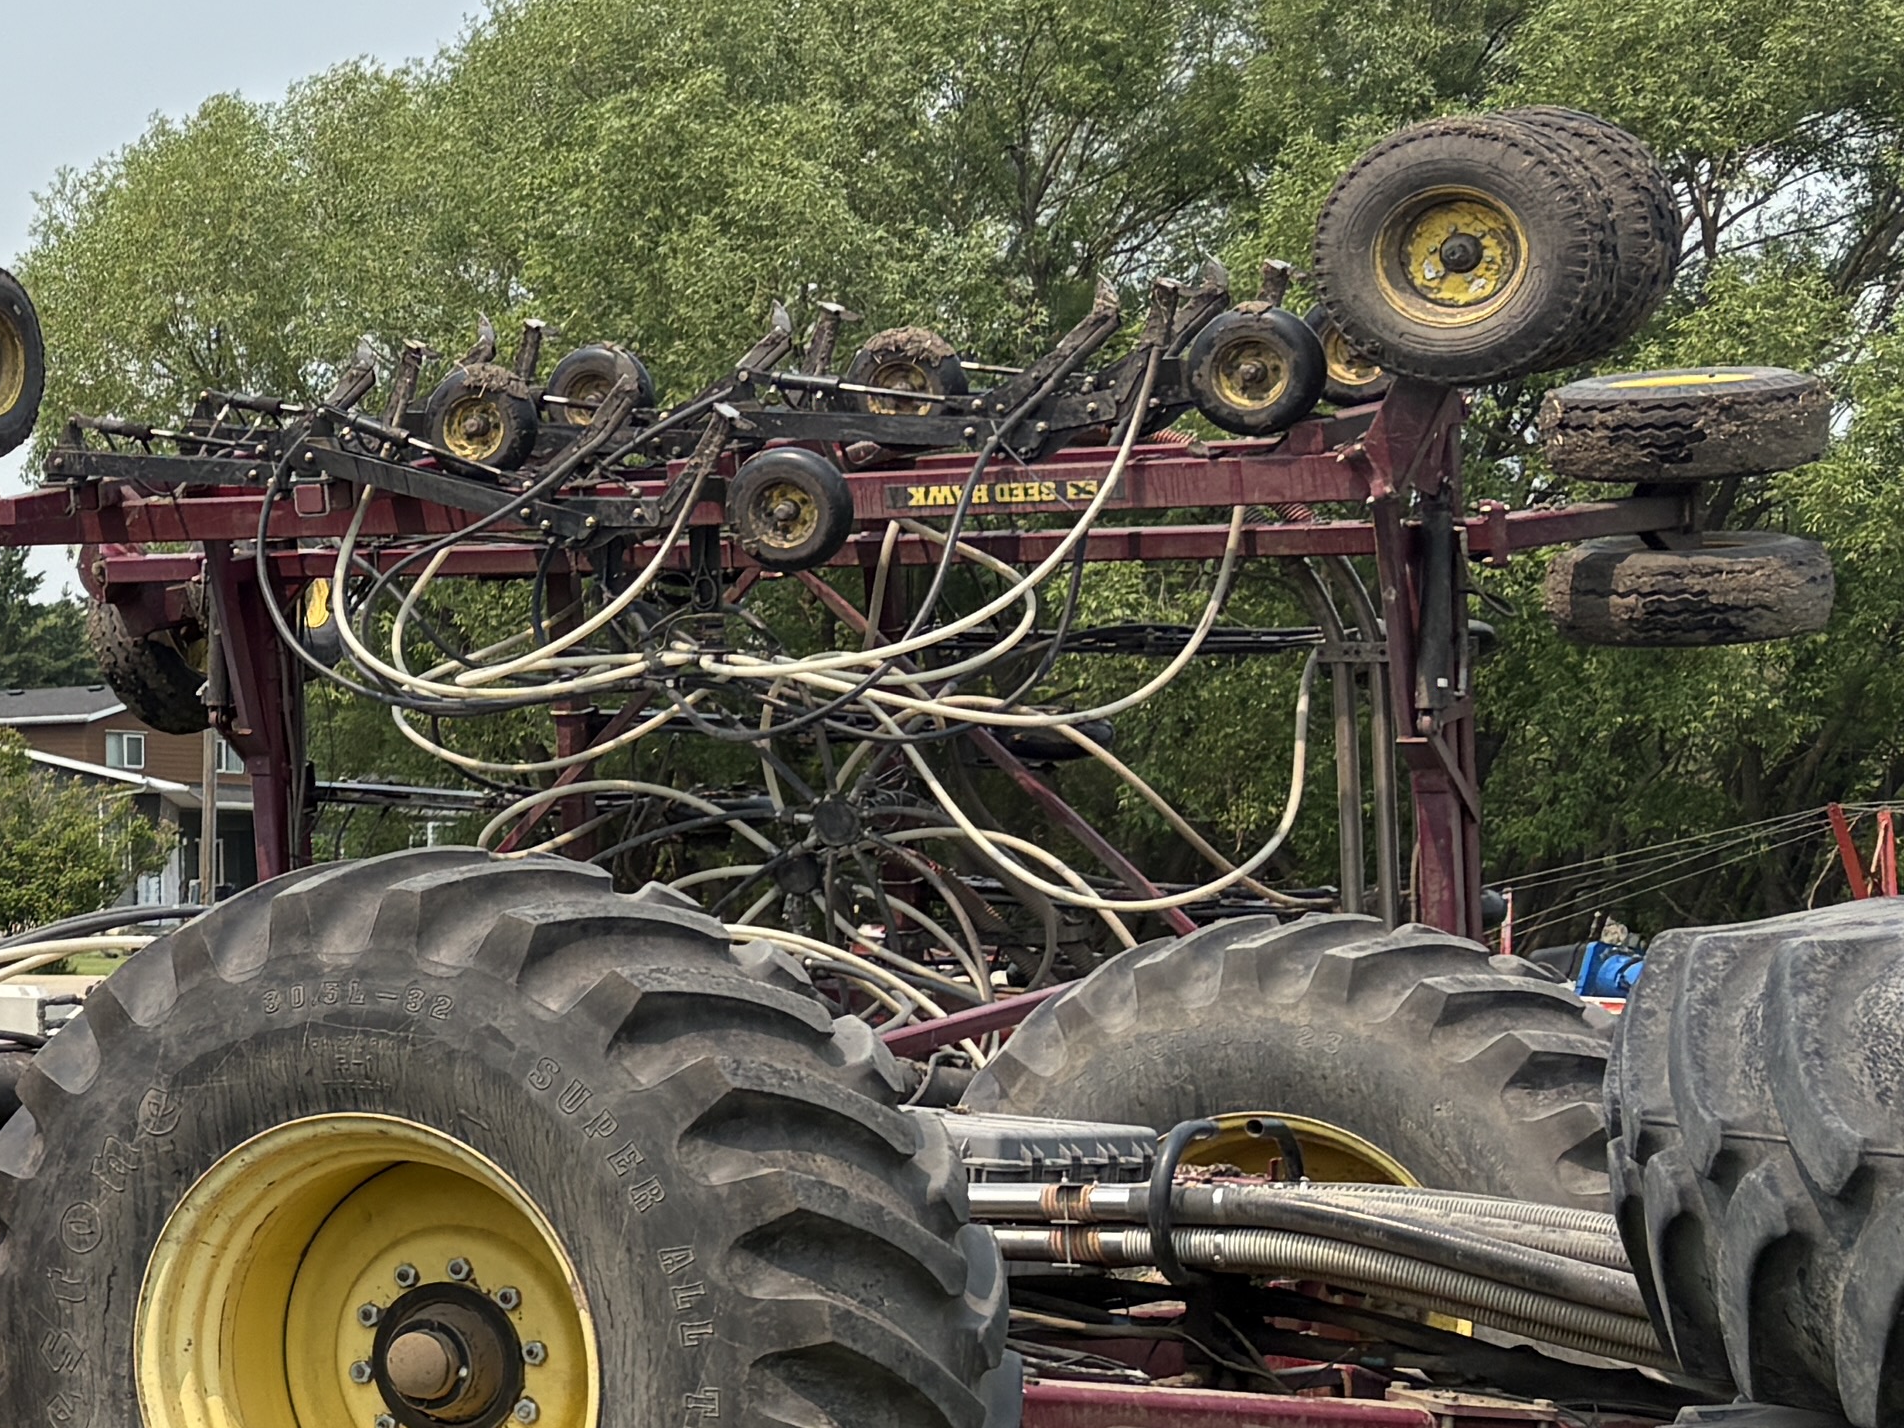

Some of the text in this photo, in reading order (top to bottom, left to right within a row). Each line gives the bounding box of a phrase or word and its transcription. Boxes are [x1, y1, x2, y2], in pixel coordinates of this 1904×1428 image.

[995, 481, 1056, 503] SEED
[528, 1055, 668, 1216] SUPER
[659, 1243, 716, 1350] ALL
